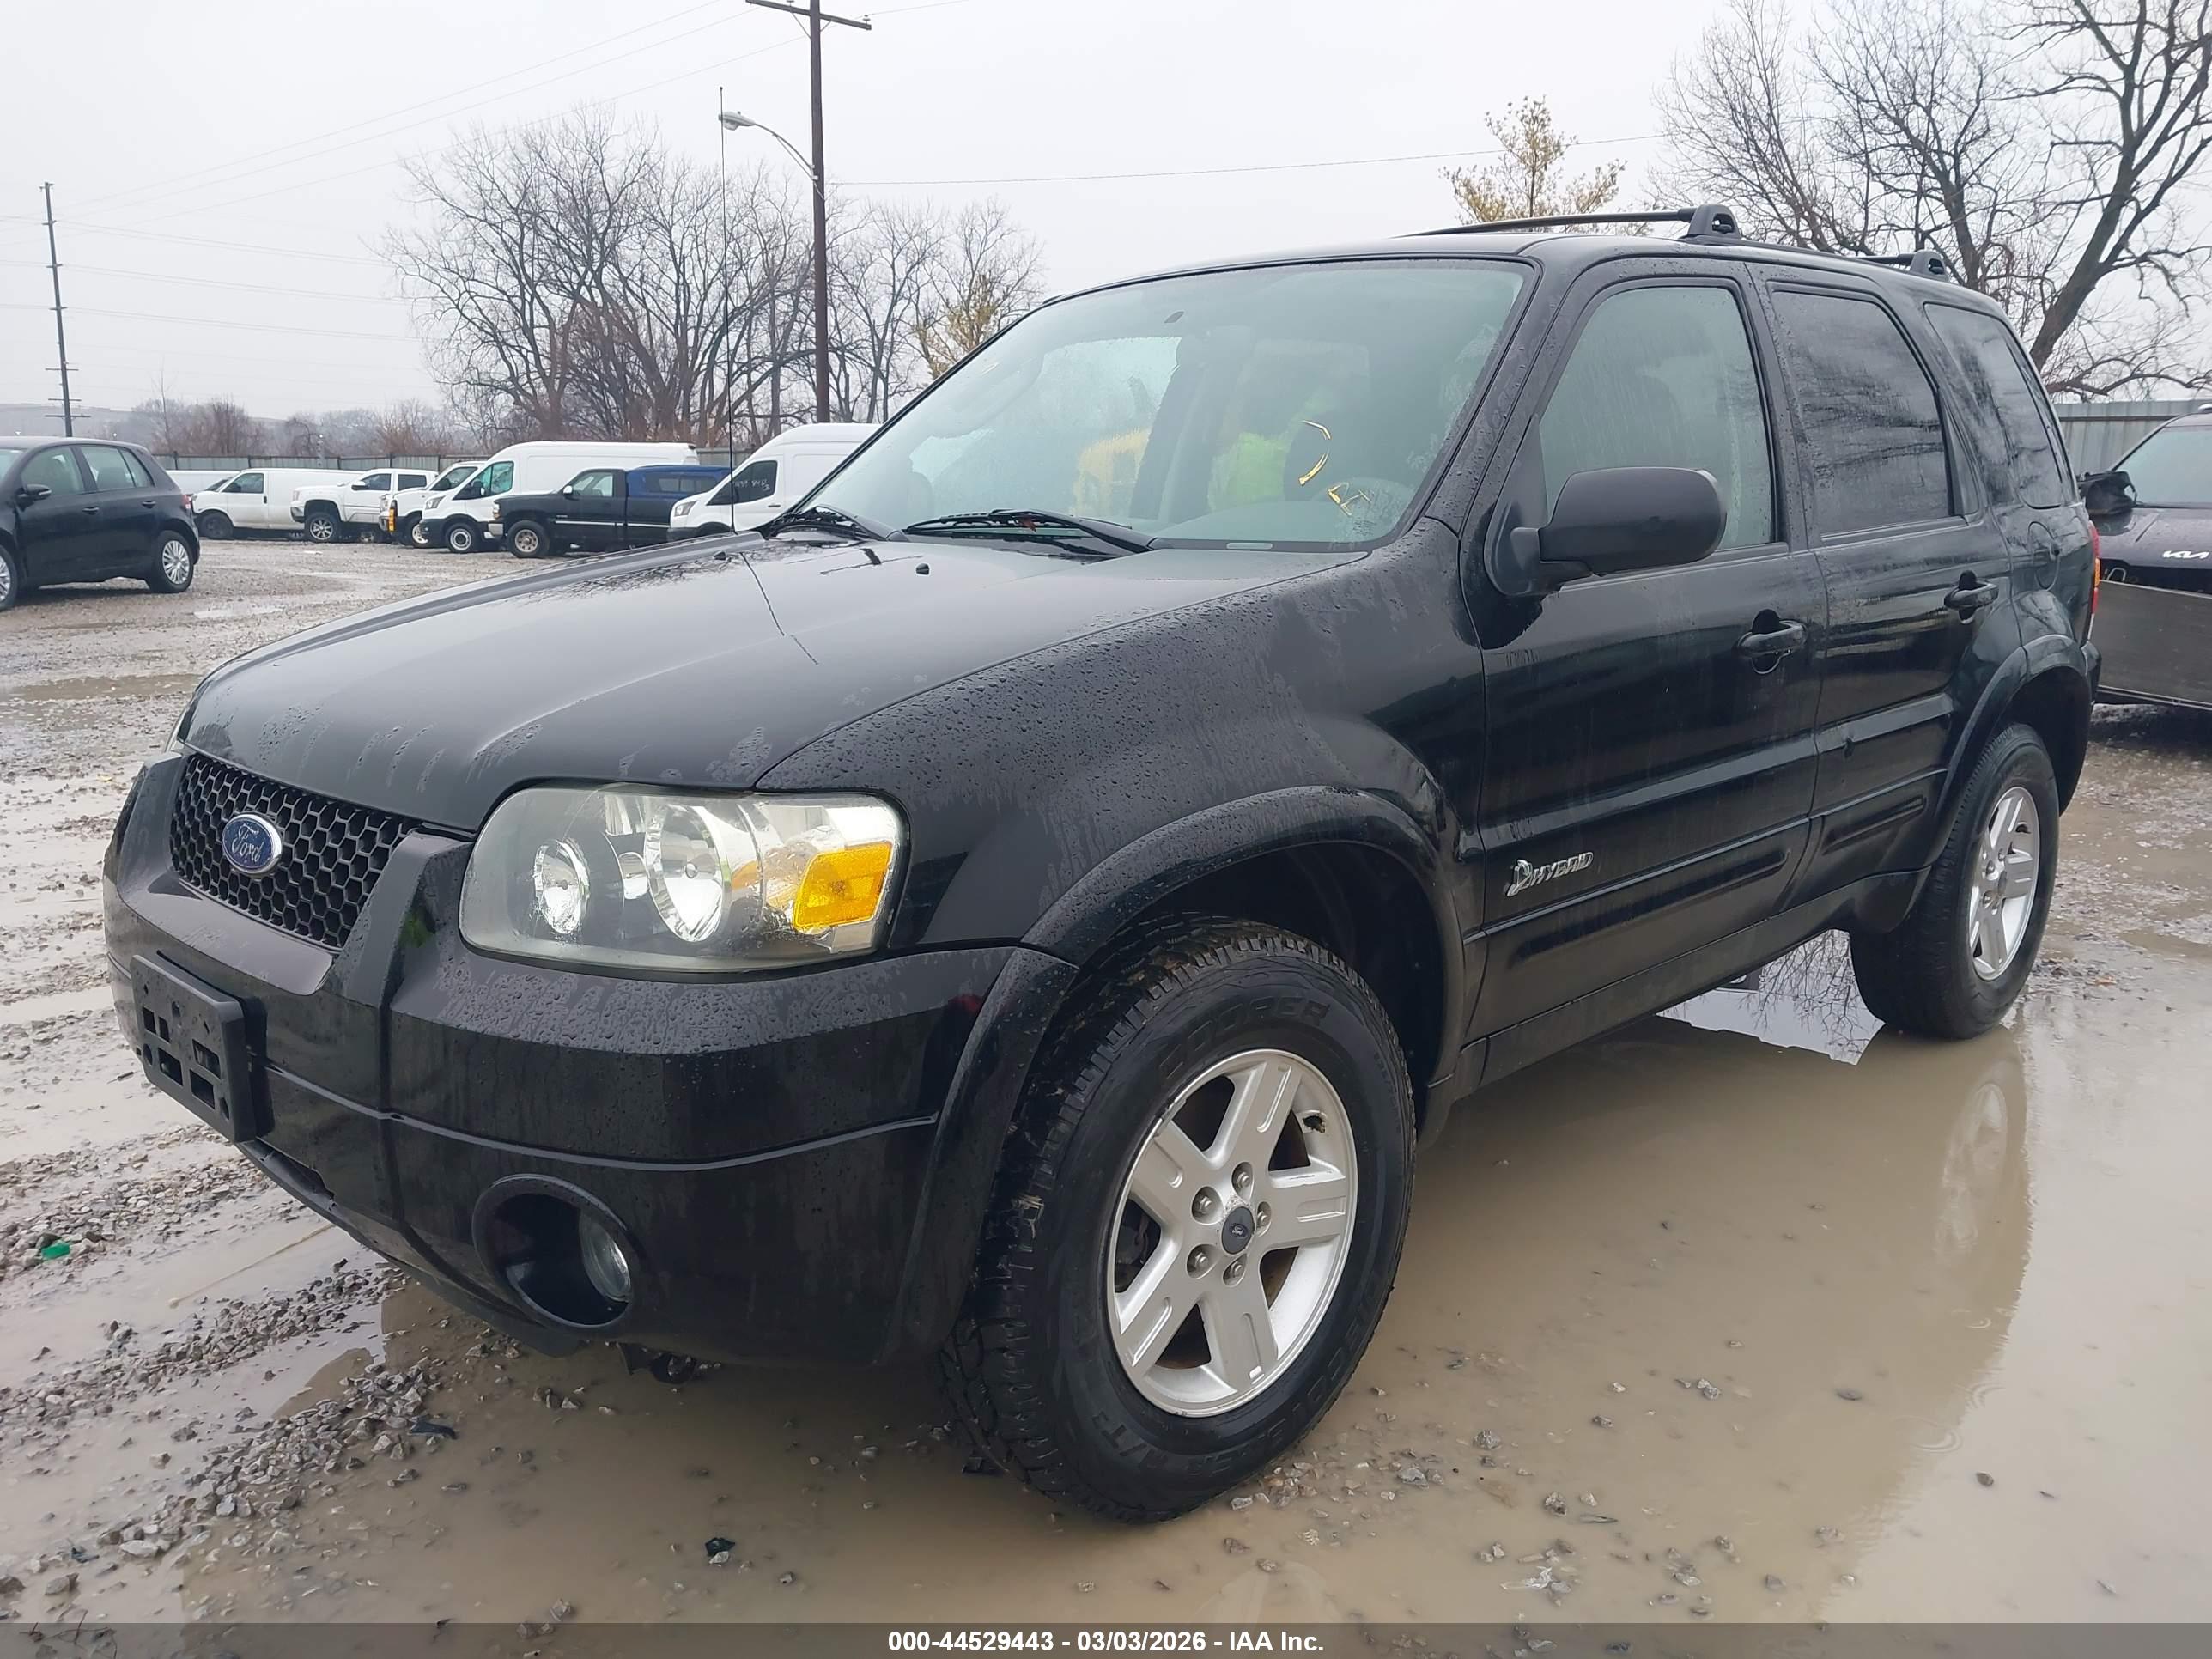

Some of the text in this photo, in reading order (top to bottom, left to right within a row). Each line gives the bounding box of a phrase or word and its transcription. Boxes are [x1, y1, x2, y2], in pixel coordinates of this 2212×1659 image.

[232, 823, 264, 863] Ford
[1531, 851, 1594, 885] HYBRID
[1158, 994, 1332, 1080] COOPER
